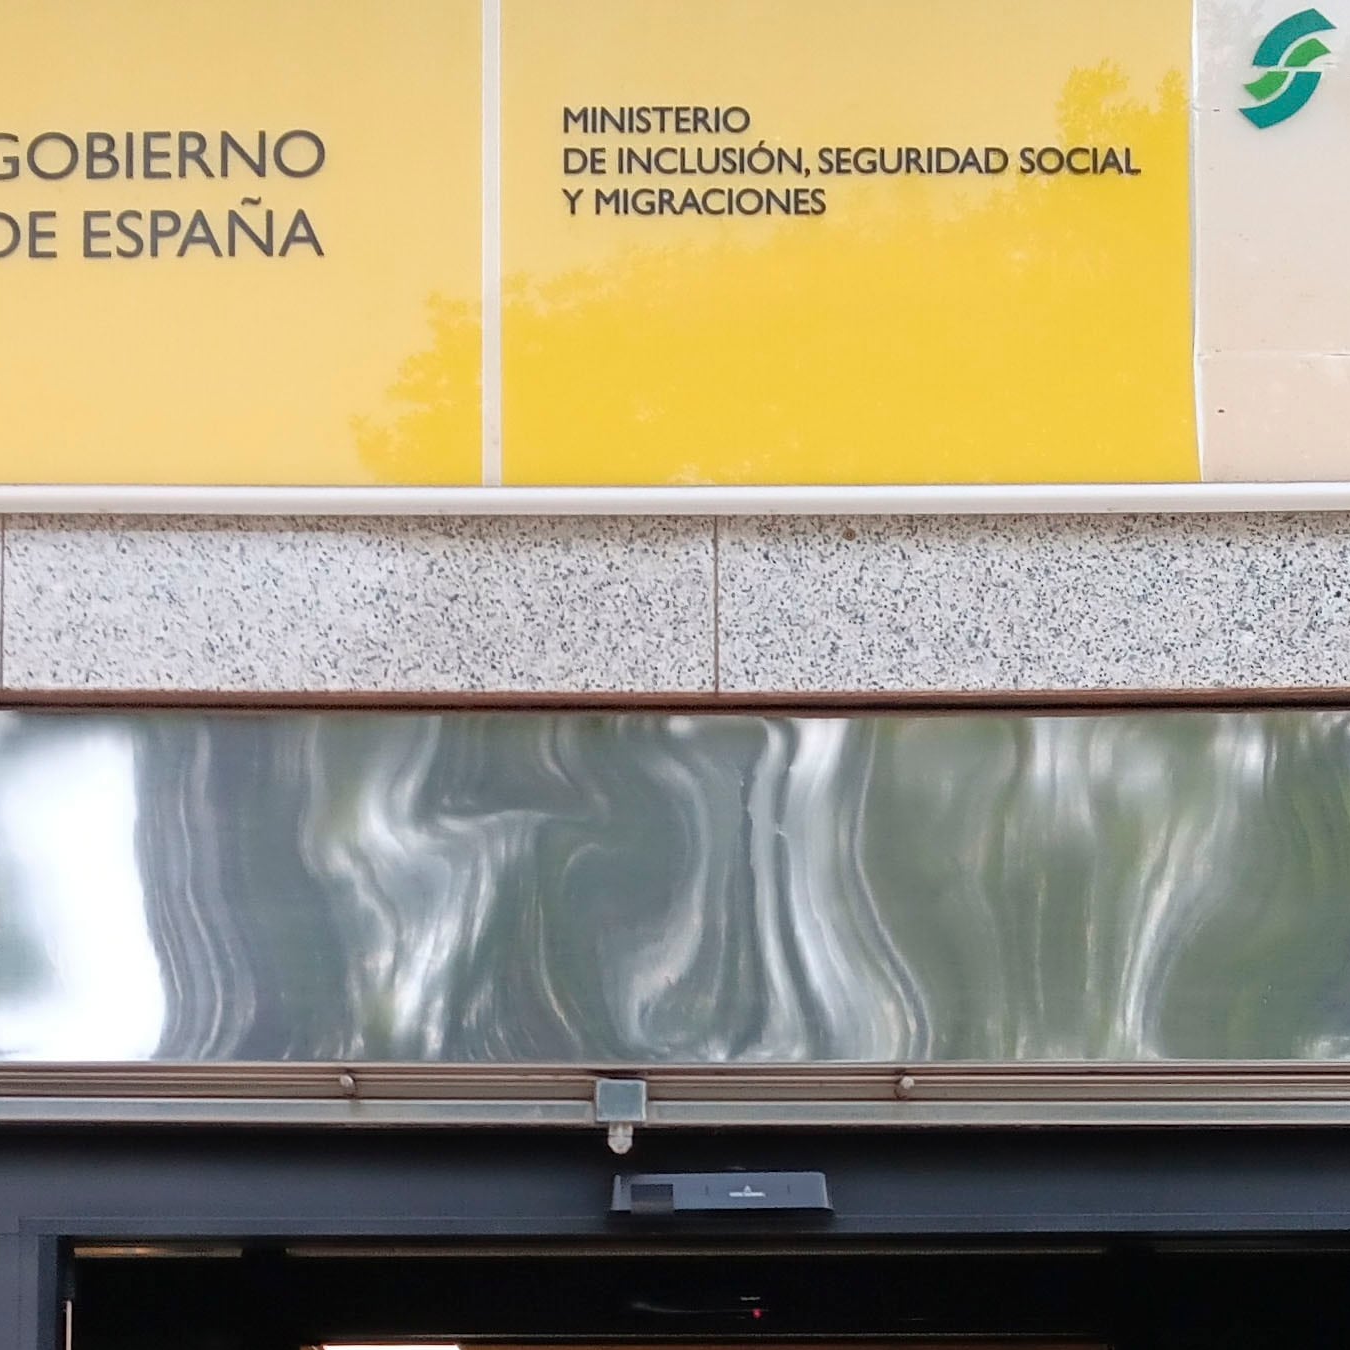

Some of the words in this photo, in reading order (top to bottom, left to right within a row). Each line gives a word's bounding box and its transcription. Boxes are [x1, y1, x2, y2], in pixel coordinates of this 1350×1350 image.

[562, 106, 751, 135] MINISTERIO
[563, 147, 607, 176] DE
[617, 140, 811, 179] INCLUSIÓN,
[818, 146, 1009, 176] SEGURIDAD
[1020, 146, 1142, 176] SOCIAL
[561, 188, 584, 216] Y
[595, 187, 827, 216] MIGRACIONES
[82, 196, 325, 259] ESPAÑA
